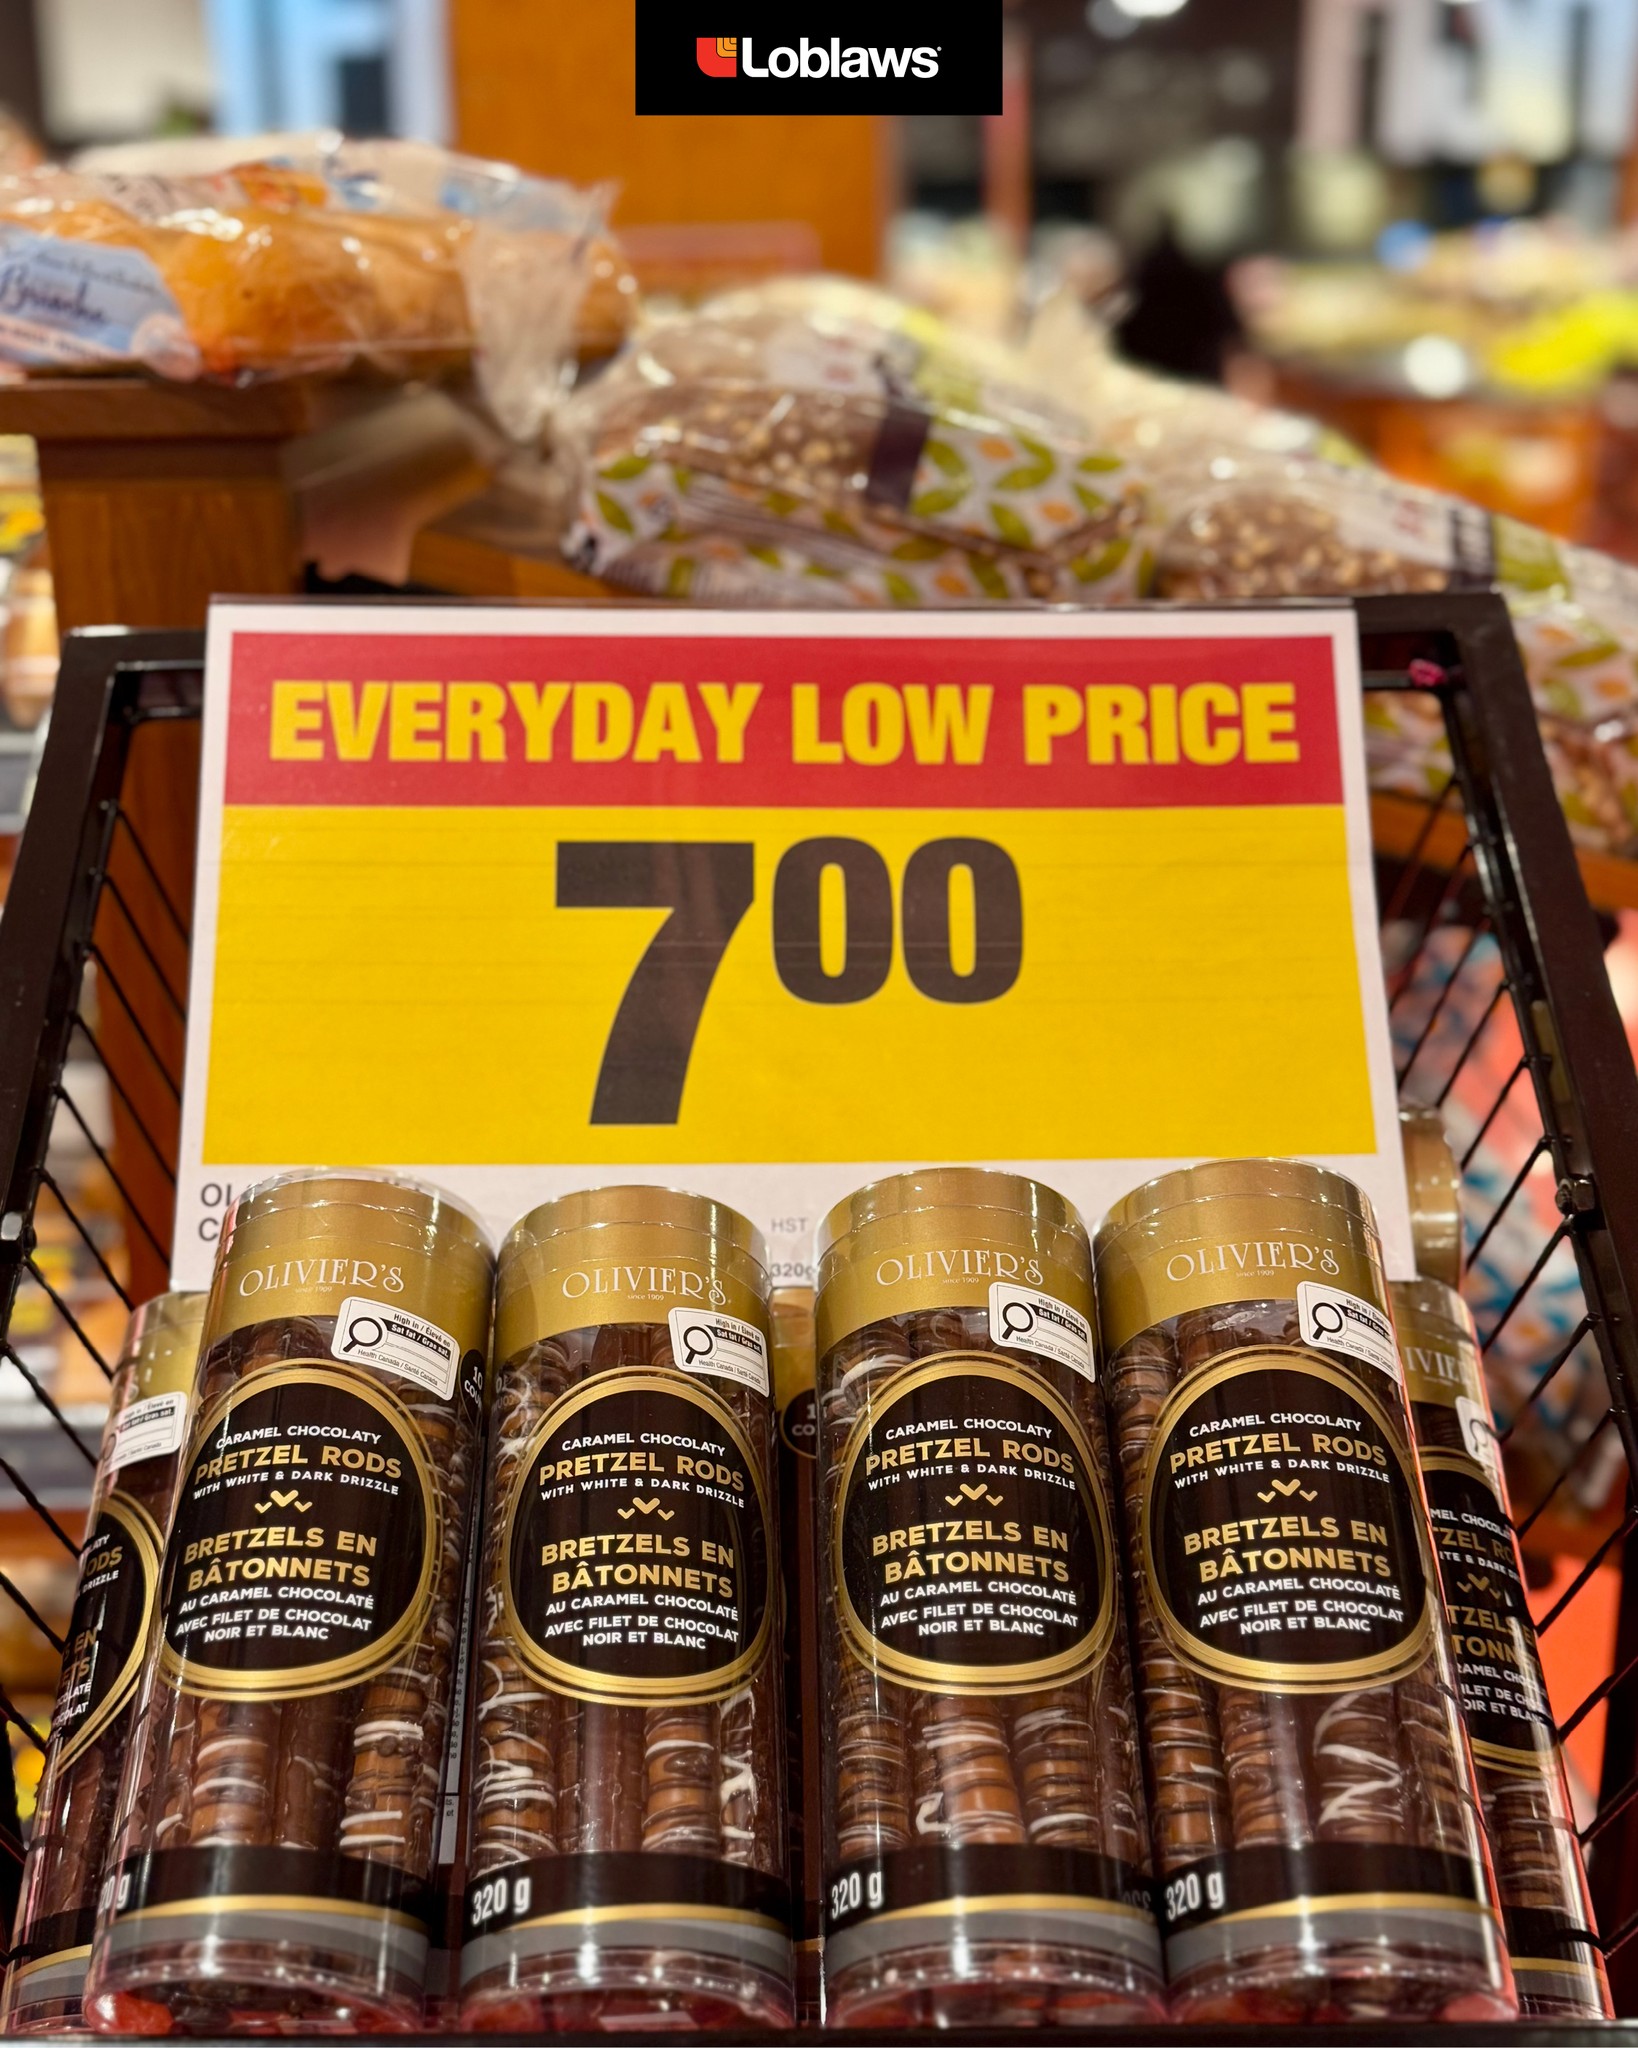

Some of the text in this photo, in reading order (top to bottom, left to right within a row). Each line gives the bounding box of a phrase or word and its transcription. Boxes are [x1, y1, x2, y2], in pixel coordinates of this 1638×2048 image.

[268, 679, 1299, 766] EVERYDAY LOW PRICE
[771, 1217, 808, 1233] HST
[240, 1258, 404, 1293] OLIVIER'S
[877, 1250, 1043, 1285] OLIVIER'S
[1167, 1241, 1339, 1281] OLIVIER'S
[562, 1266, 726, 1305] OLIVIER'S
[392, 1324, 404, 1333] Sat
[406, 1329, 417, 1341] fat
[422, 1337, 437, 1350] Gras
[438, 1345, 449, 1358] sat.
[358, 1349, 377, 1360] Health
[378, 1355, 400, 1367] Canada
[404, 1364, 420, 1375] Santé
[420, 1371, 438, 1386] Canada
[473, 1366, 483, 1390] 10
[216, 1426, 382, 1449] CARAMEL CHOCOLATY
[886, 1419, 1052, 1440] CARAMEL CHOCOLATY
[1189, 1413, 1361, 1437] CARAMEL CHOCOLATY
[562, 1434, 725, 1456] CARAMEL CHOCOLATY
[866, 1438, 1075, 1476] PRETZEL RODS
[1170, 1433, 1387, 1474] PRETZEL RODS
[194, 1445, 308, 1485] PRETZEL
[321, 1446, 402, 1479] RODS
[539, 1452, 744, 1491] PRETZEL RODS
[868, 1464, 1075, 1491] WITH WHITE & DARK DRIZZLE
[1175, 1459, 1389, 1489] WITH WHITE & DARK DRIZZLE
[193, 1471, 399, 1500] WITH WHITE & DARK DRIZZLE
[541, 1478, 744, 1508] WITH WHITE & DARK DRIZZLE
[183, 1527, 377, 1565] BRETZELS EN
[873, 1521, 1068, 1557] BRETZELS EN
[1184, 1516, 1388, 1555] BRETZELS EN
[85, 1546, 123, 1576] ODS
[542, 1534, 734, 1568] BRETZELS EN
[1200, 1548, 1391, 1583] BÂTONNETS
[1439, 1551, 1461, 1562] ITE
[188, 1557, 370, 1592] BÂTONNETS
[552, 1561, 733, 1598] BÂTONNETS
[885, 1550, 1069, 1584] BÂTONNETS
[179, 1587, 374, 1614] AU CARAMEL CHOCOLATÉ
[880, 1581, 1076, 1607] AU CARAMEL CHOCOLATÉ
[1197, 1578, 1401, 1606] AU CARAMEL CHOCOLATÉ
[546, 1594, 738, 1621] AU CARAMEL CHOCOLATÉ
[881, 1603, 1078, 1629] AVEC FILET DE CHOCOLAT
[1200, 1600, 1404, 1628] AVEC FILET DE CHOCOLAT
[175, 1609, 372, 1637] AVEC FILET DE CHOCOLAT
[204, 1625, 328, 1643] NOIR ET BLANC
[545, 1616, 739, 1643] AVEC FILET DE CHOCOLAT
[919, 1620, 1044, 1636] NOIR ET BLANC
[1240, 1618, 1371, 1635] NOIR ET BLANC
[583, 1632, 706, 1649] NOIR ET BLANC
[1461, 1684, 1513, 1700] ILET DE
[1464, 1700, 1487, 1712] OIR
[1490, 1702, 1506, 1714] ET
[117, 1873, 131, 1909] g
[471, 1876, 531, 1927] 320 g
[831, 1870, 883, 1920] 320 g
[1166, 1871, 1200, 1922] 320
[1206, 1870, 1224, 1908] g
